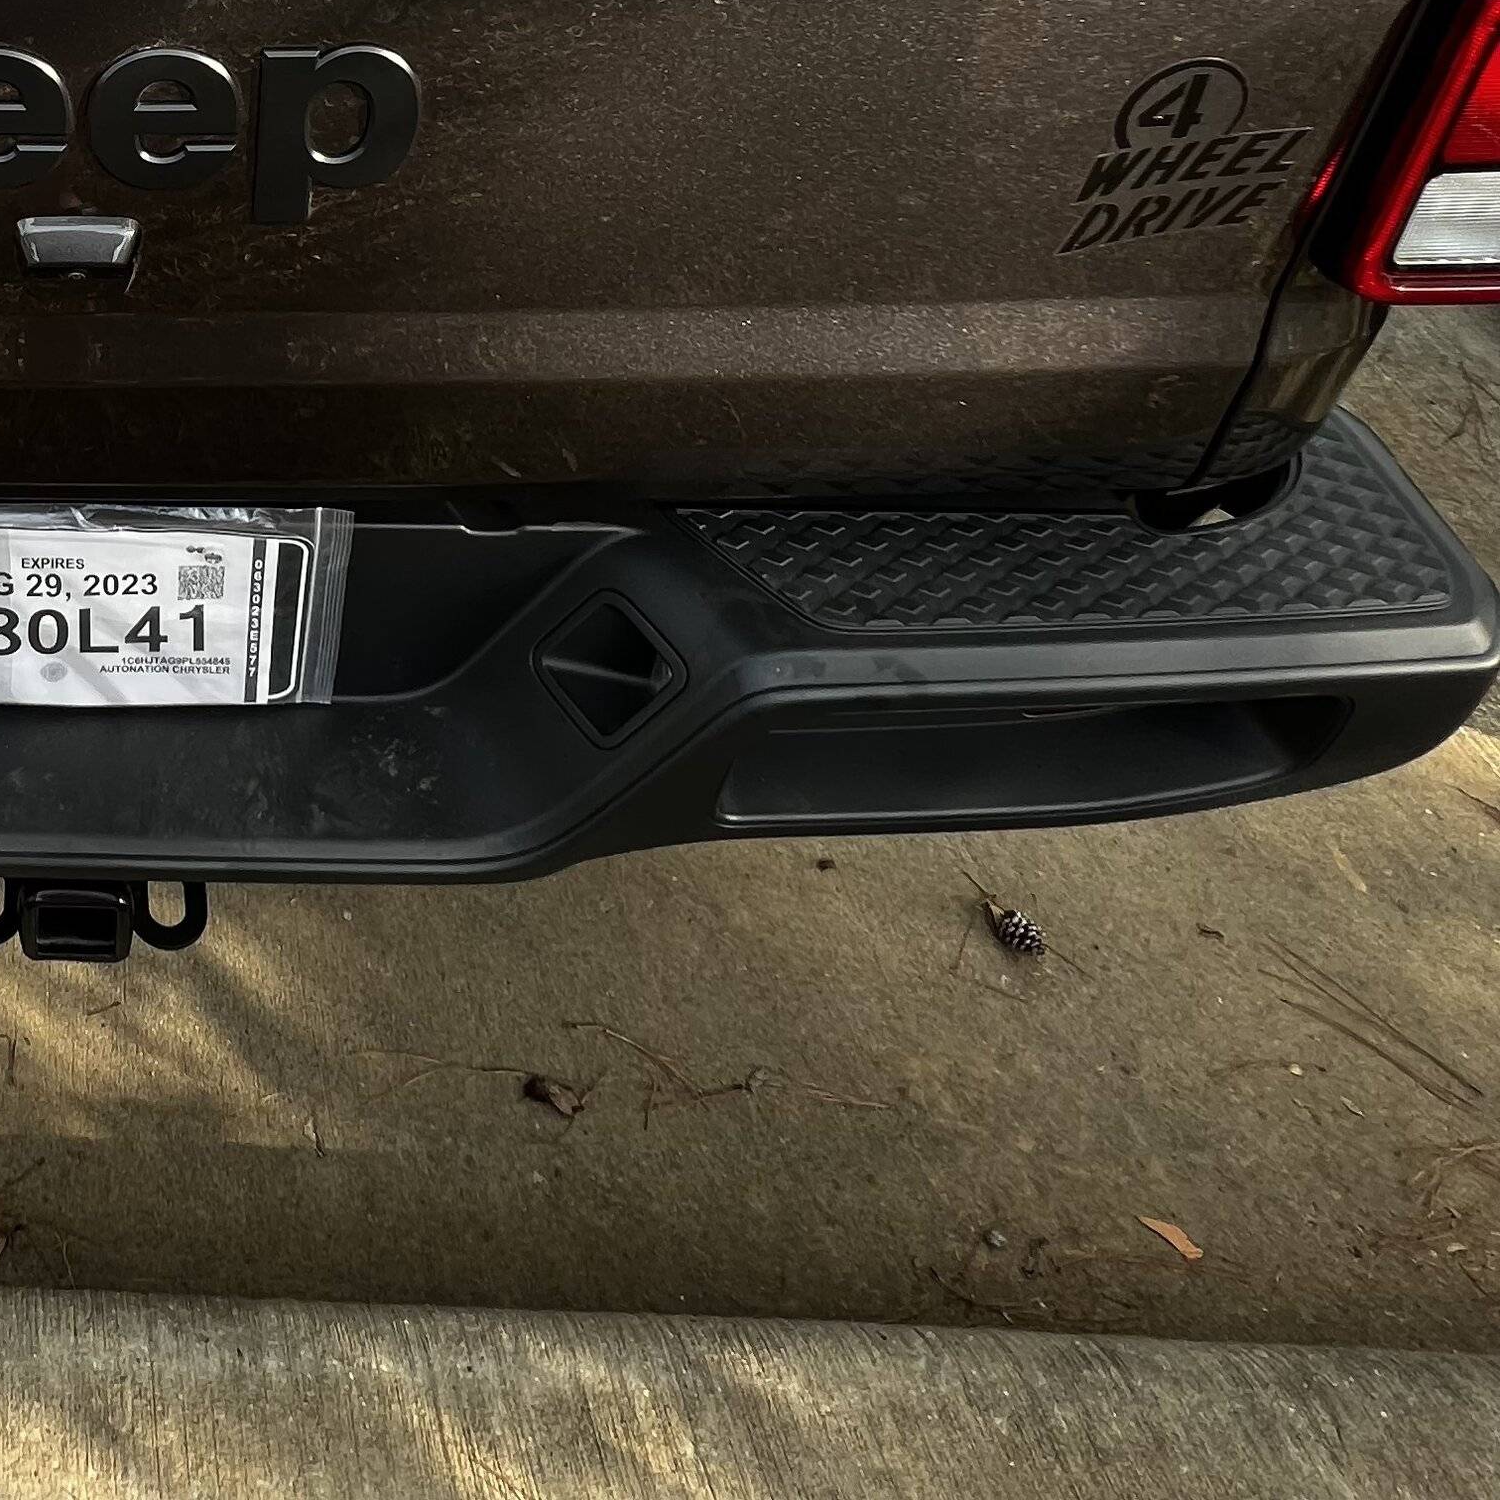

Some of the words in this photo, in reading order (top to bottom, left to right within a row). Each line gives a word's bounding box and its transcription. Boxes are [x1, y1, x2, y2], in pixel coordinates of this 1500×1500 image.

[1137, 73, 1211, 139] 4
[1074, 128, 1313, 204] WHEEL
[1055, 181, 1286, 254] DRIVE
[21, 558, 85, 570] EXPIRES
[26, 573, 71, 601] 29,
[83, 573, 158, 597] 2023
[100, 665, 169, 674] AUTONATION
[172, 665, 230, 675] CHRYSLER
